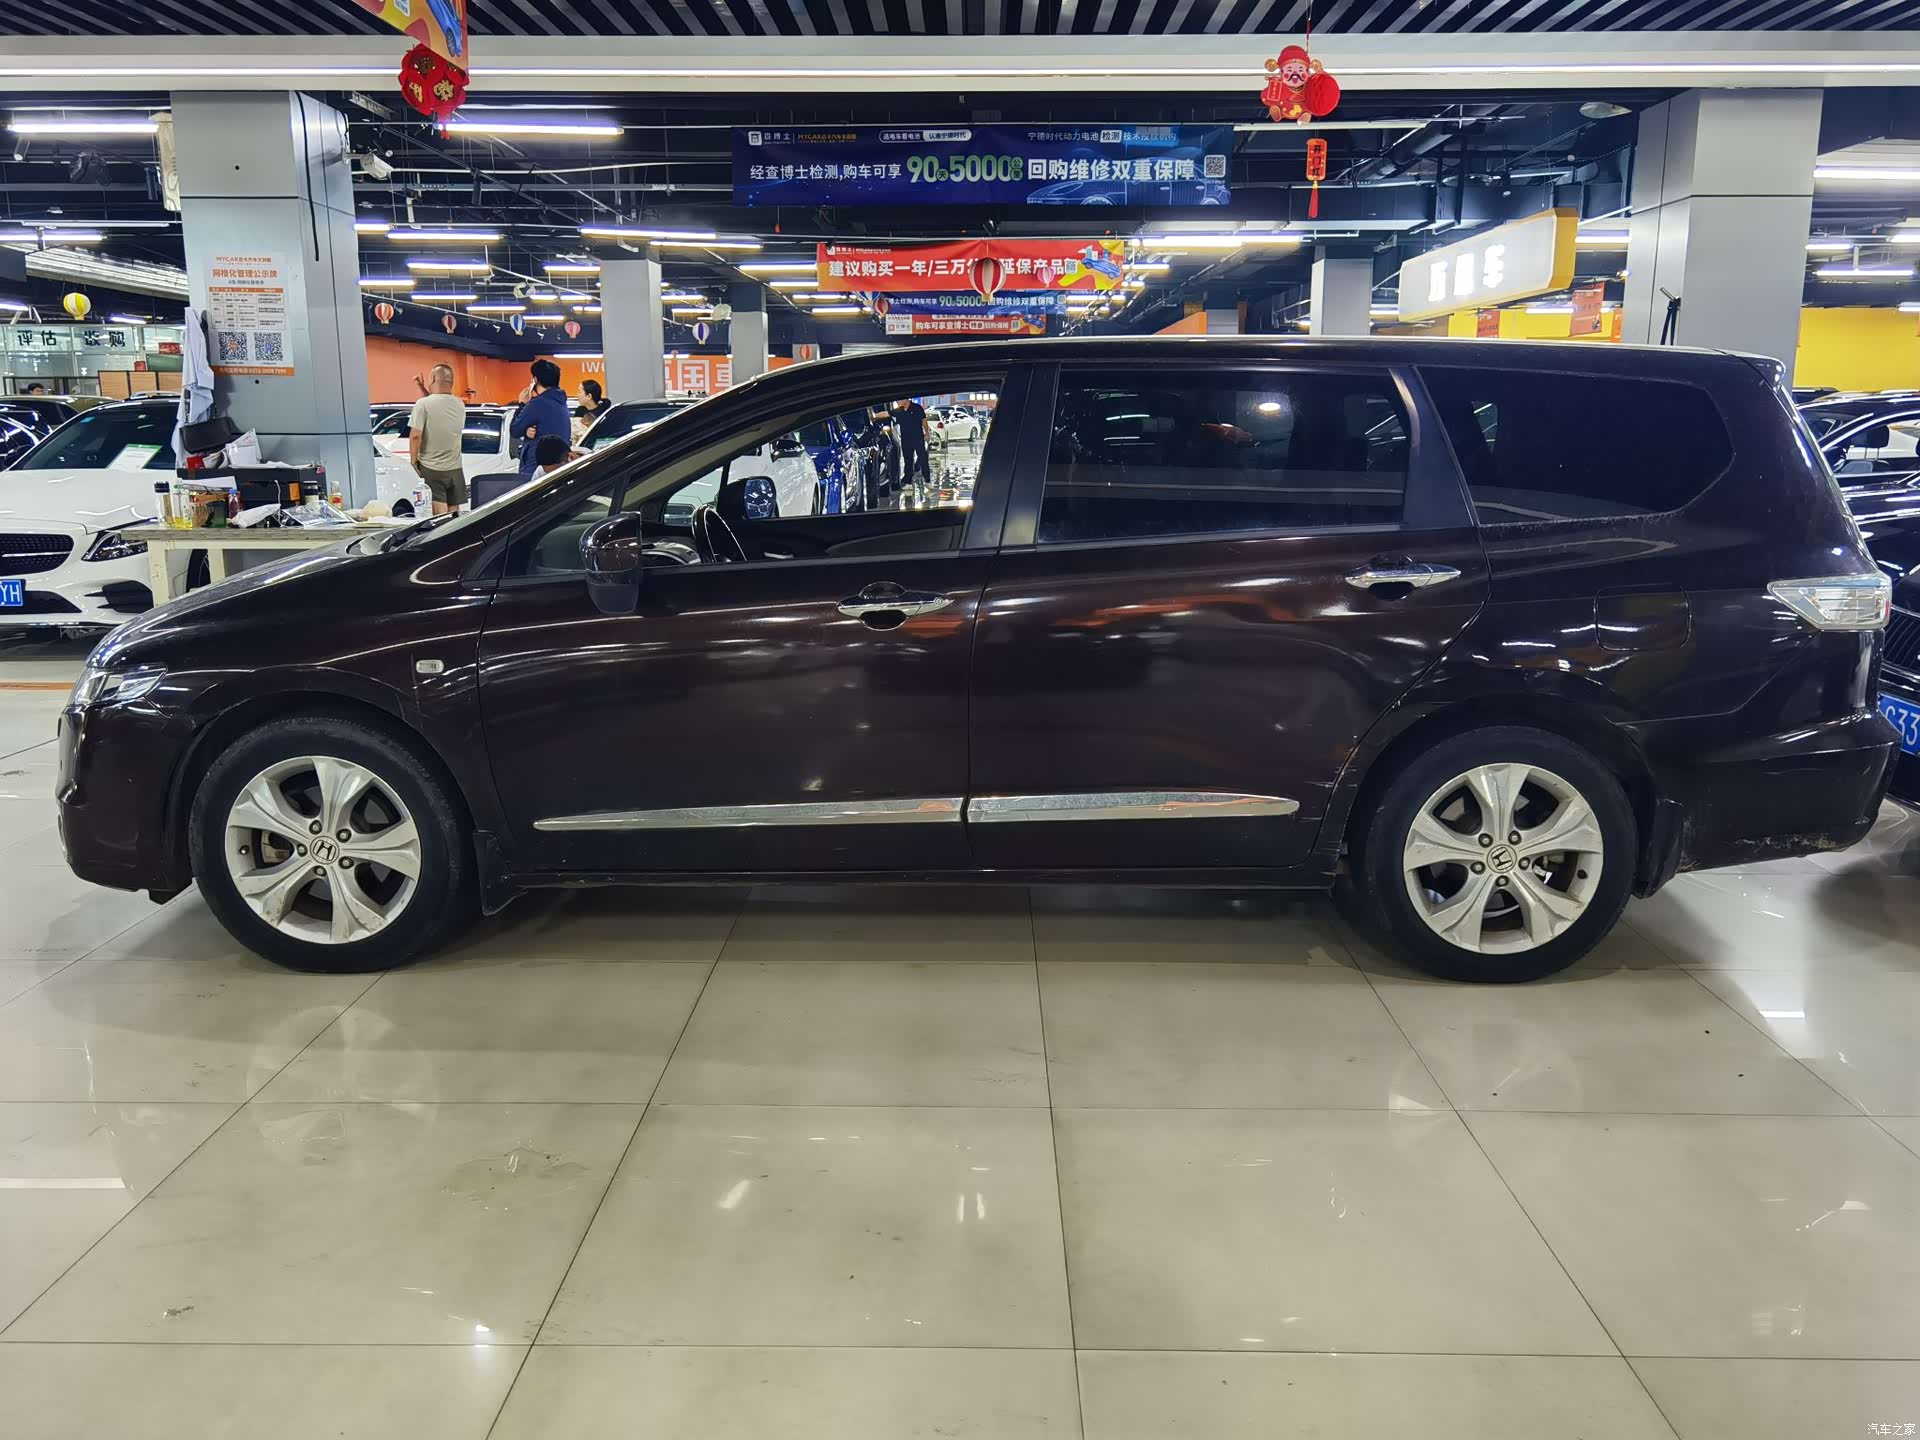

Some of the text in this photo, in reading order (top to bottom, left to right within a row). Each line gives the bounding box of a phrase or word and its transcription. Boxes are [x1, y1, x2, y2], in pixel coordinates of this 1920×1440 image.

[750, 164, 902, 180] 经查博士检测,购车可享
[1028, 158, 1195, 181] 回购维修双重保障
[17, 330, 57, 346] 评估
